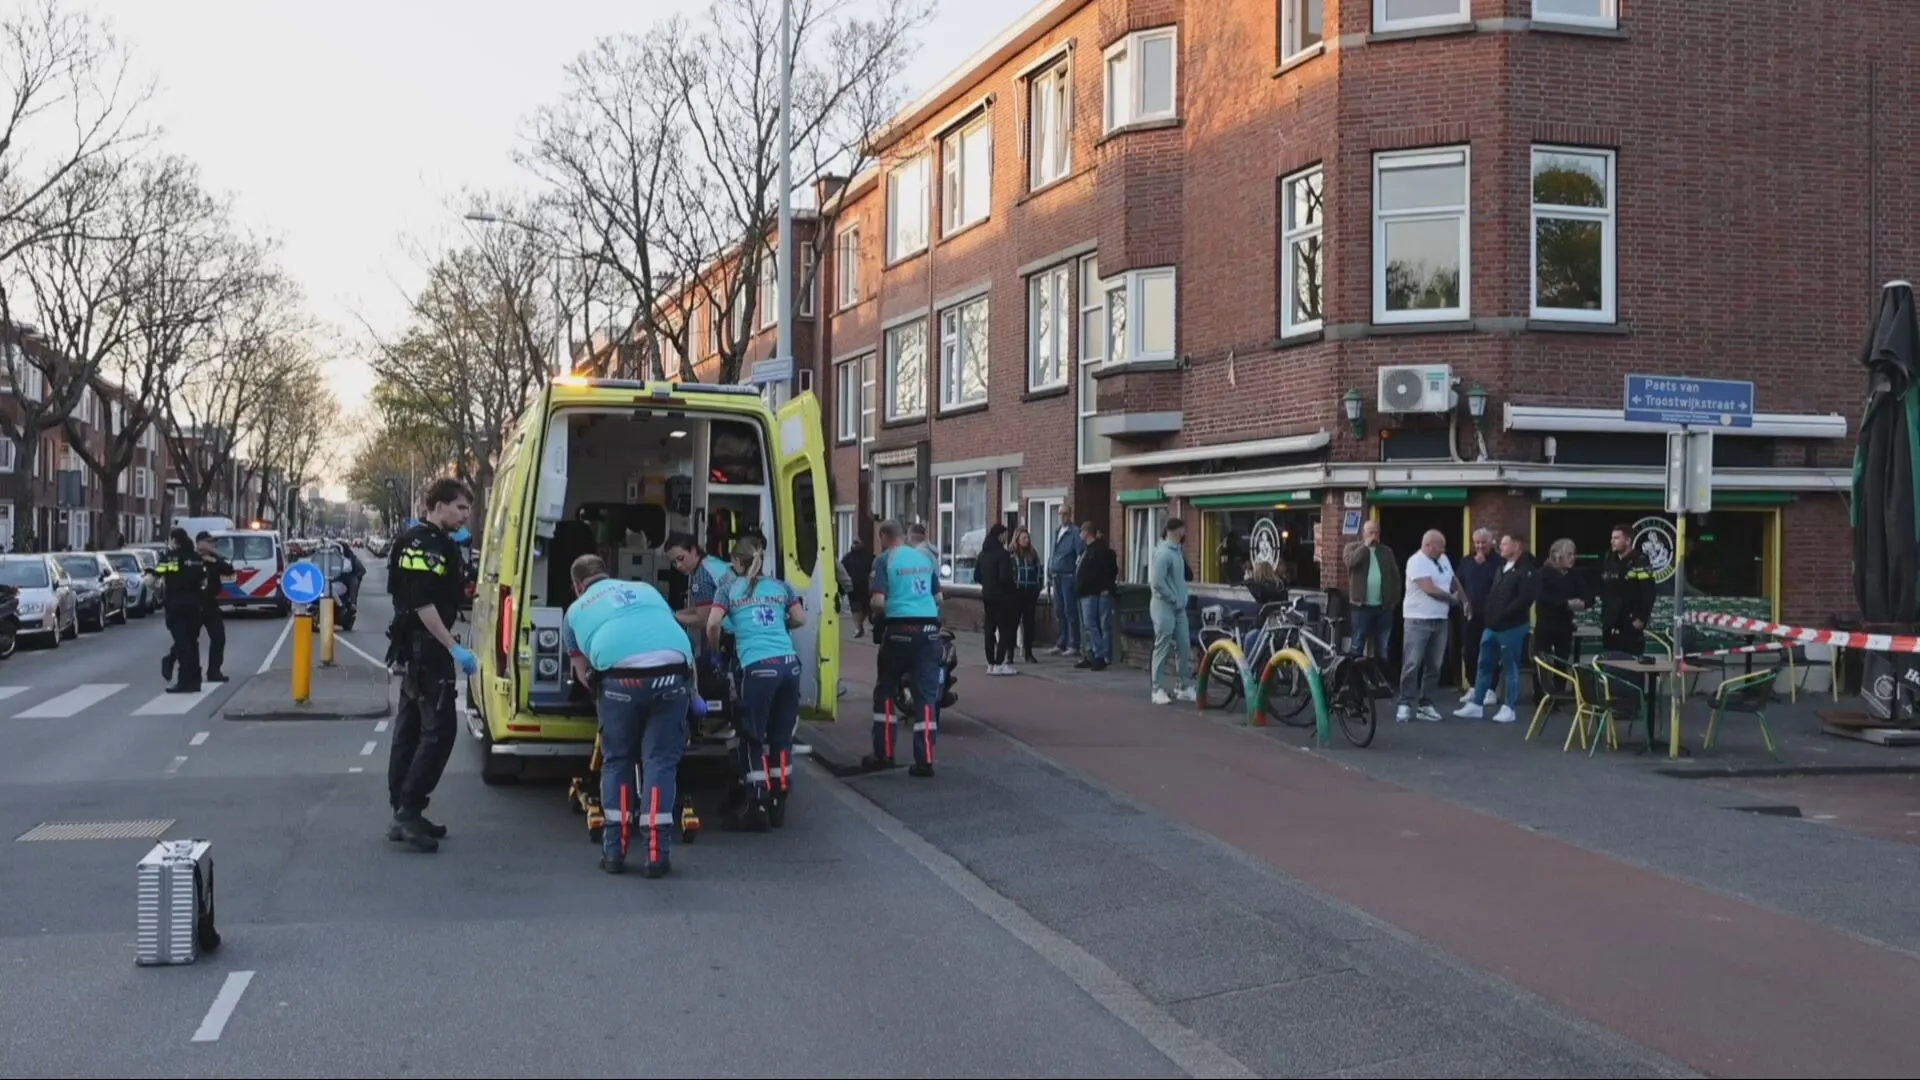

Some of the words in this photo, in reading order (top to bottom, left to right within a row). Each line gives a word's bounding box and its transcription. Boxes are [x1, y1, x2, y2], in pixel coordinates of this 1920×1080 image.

[1645, 379, 1677, 392] Paets
[1680, 383, 1700, 393] van
[1646, 394, 1735, 410] Troostwijkstraat
